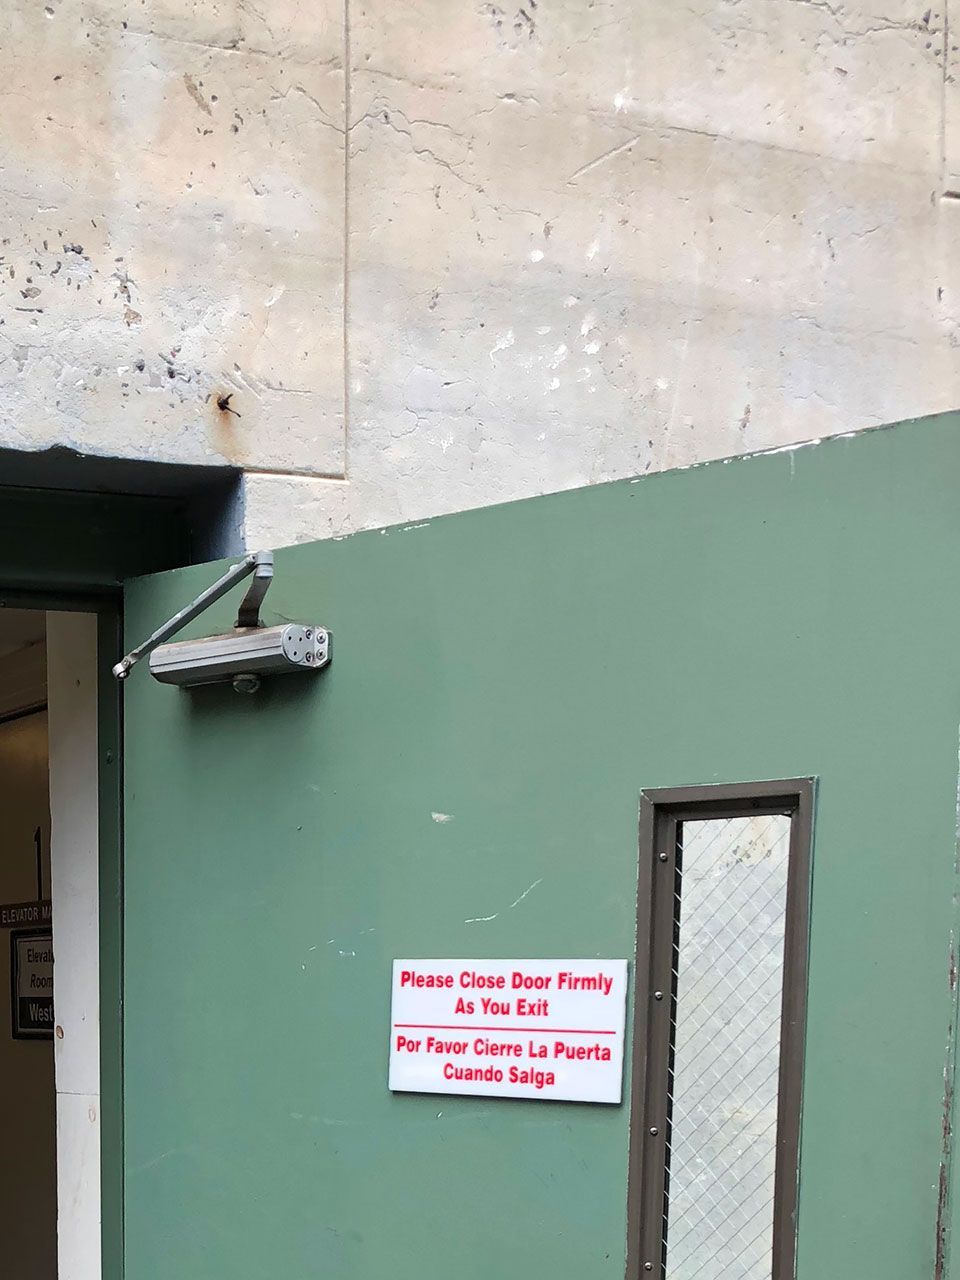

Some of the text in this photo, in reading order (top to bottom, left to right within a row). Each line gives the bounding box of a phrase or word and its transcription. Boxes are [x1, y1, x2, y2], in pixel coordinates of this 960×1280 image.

[2, 907, 39, 923] ELEVATOR
[401, 970, 613, 996] Please Close Door Firmly
[29, 1003, 53, 1021] West
[455, 998, 549, 1016] As You Exit
[397, 1036, 611, 1061] Por Favor Cierre La Puerta
[443, 1063, 555, 1089] Cuando Salga
